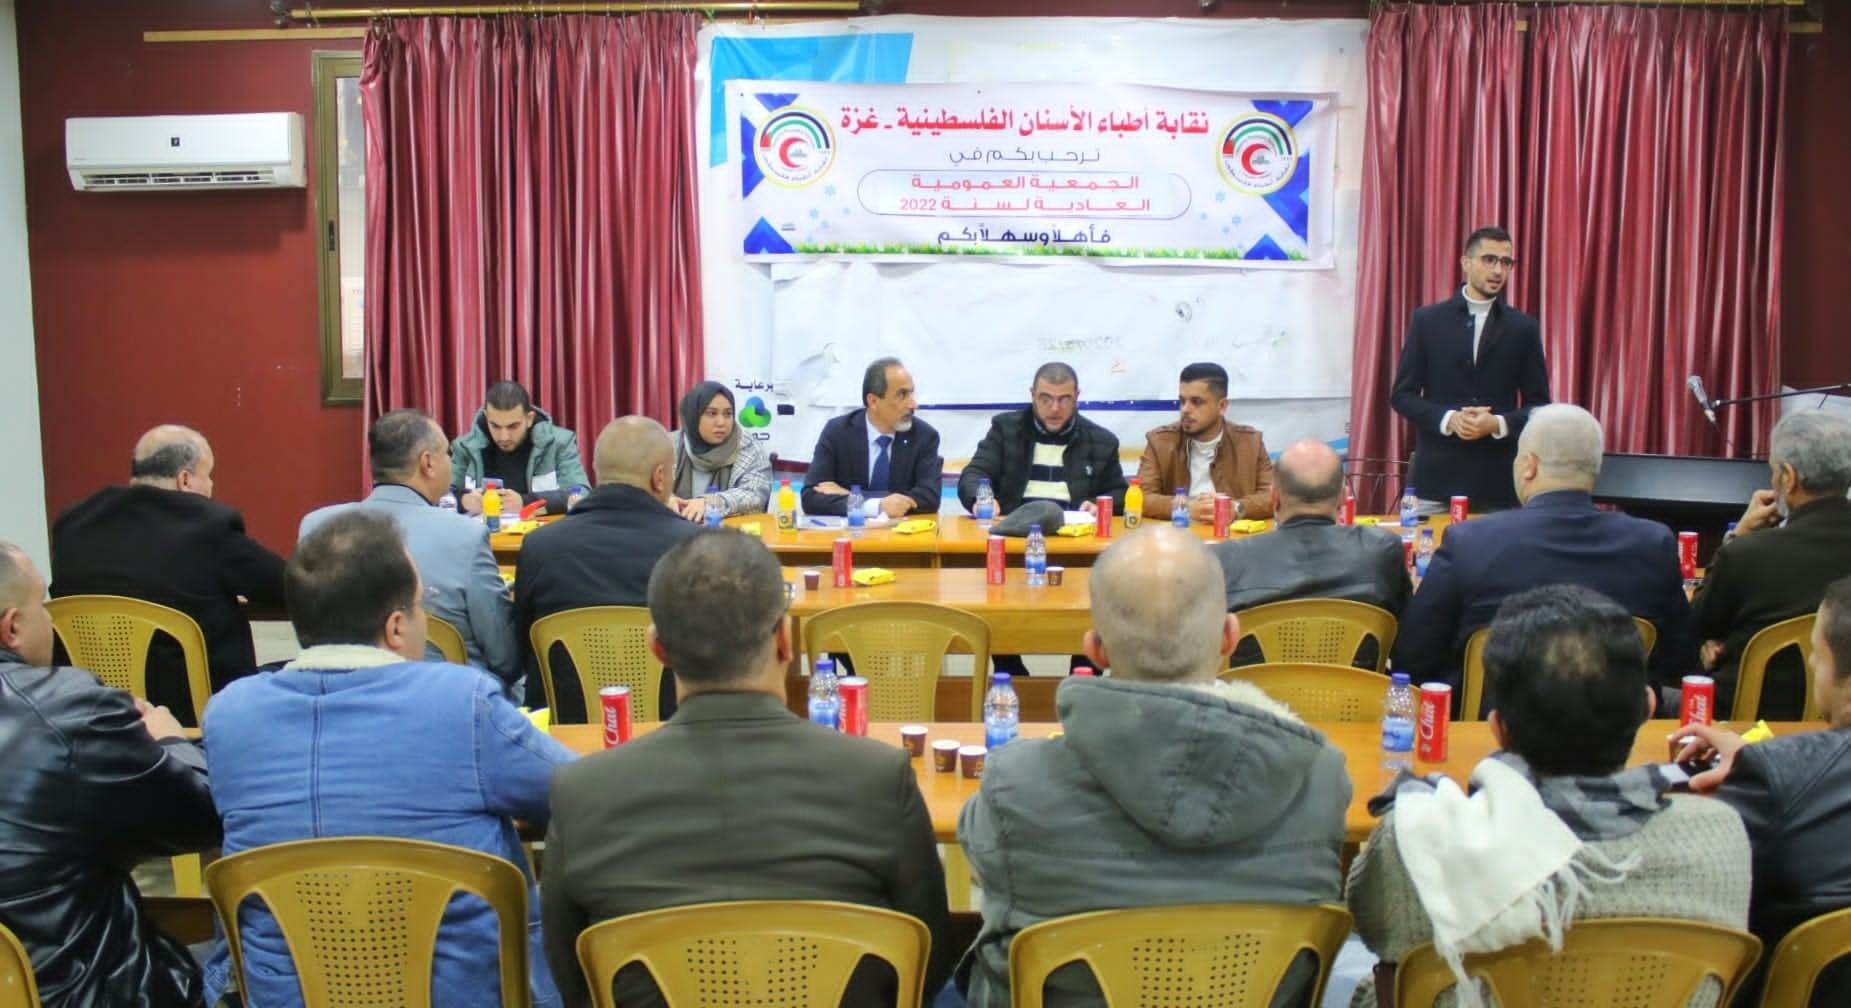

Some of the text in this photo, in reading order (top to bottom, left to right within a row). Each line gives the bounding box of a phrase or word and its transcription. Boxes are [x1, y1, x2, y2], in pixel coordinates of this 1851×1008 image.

[841, 106, 879, 135] غزة
[897, 107, 1014, 136] الفلسطينية
[1019, 104, 1093, 136] الأسنان
[1155, 110, 1209, 140] نقابة
[949, 146, 983, 168] في
[911, 173, 1140, 192] الجمعية العمومية
[900, 195, 1151, 213] العادية لسنة 2022
